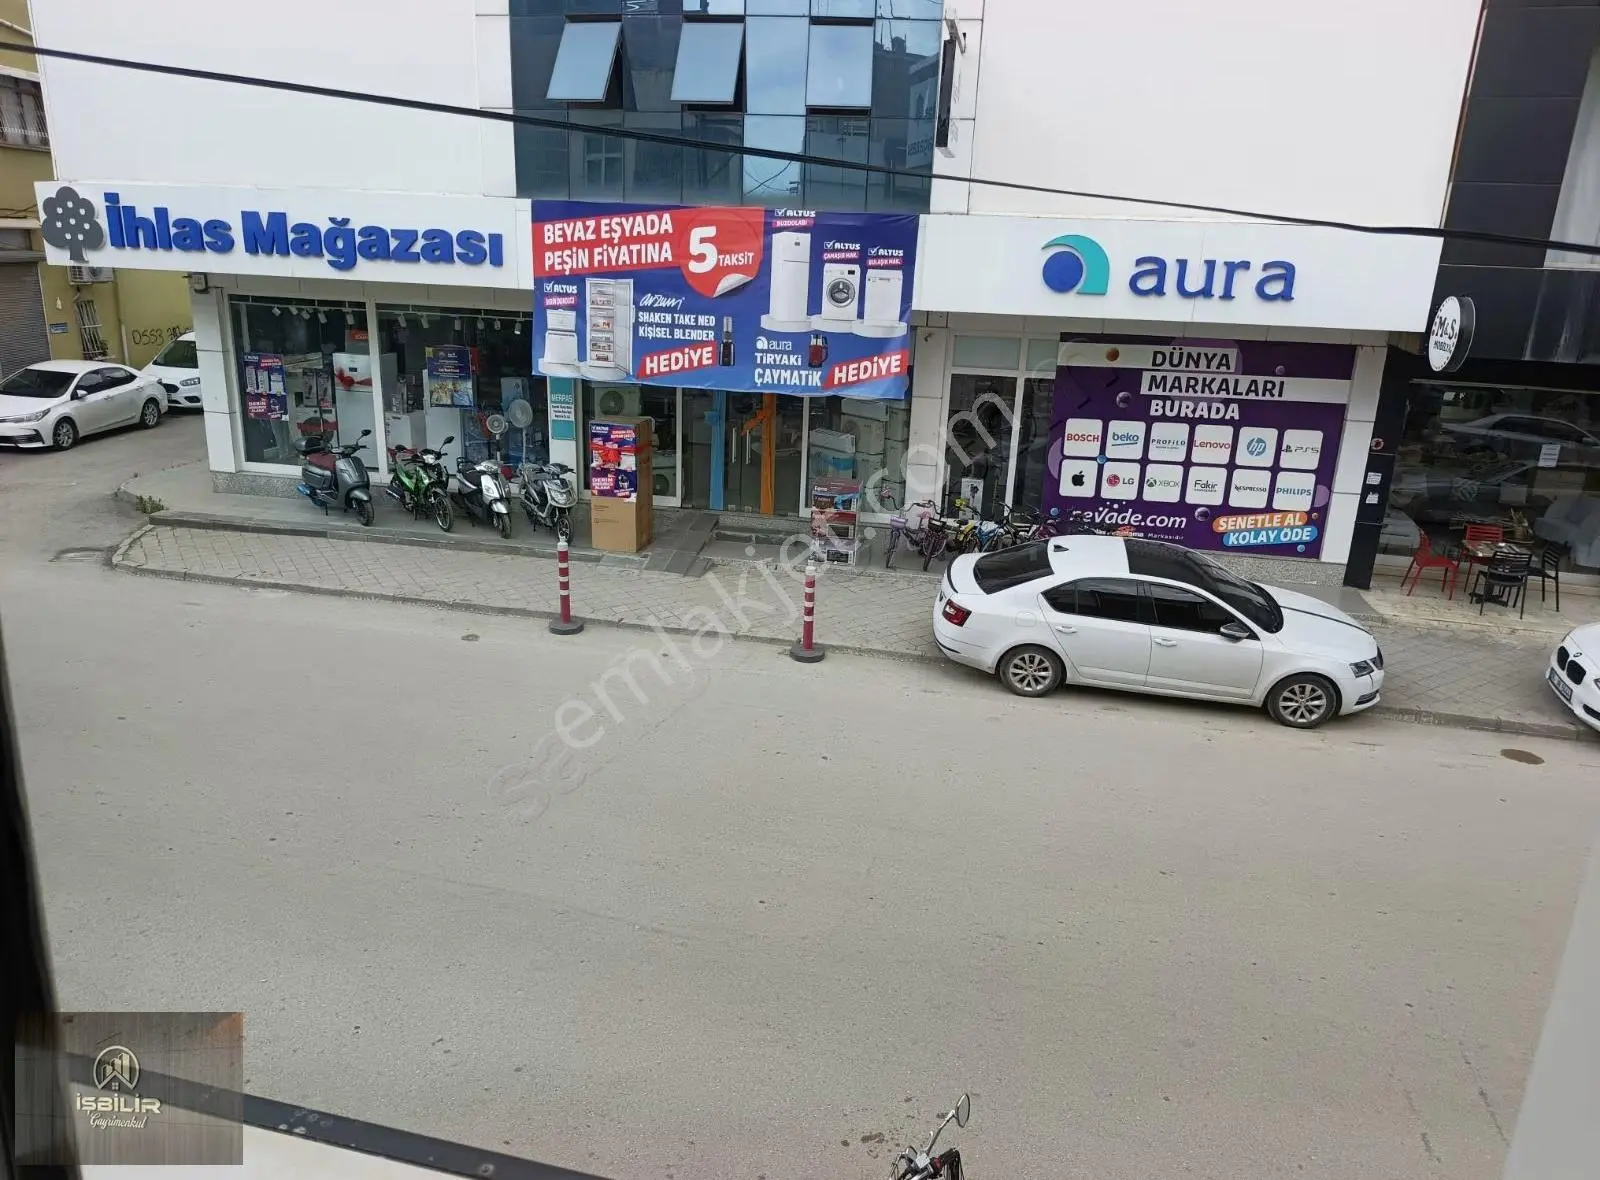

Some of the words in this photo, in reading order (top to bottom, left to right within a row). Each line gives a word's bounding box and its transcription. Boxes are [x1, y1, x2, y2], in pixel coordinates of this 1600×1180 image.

[786, 208, 817, 217] ALTUS
[104, 191, 236, 253] İhlas
[241, 210, 504, 272] Mağazası
[544, 219, 597, 245] BEYAZ
[601, 213, 673, 244] EŞYADA
[688, 226, 719, 273] 5
[834, 241, 861, 250] ALTUS
[878, 247, 904, 257] ALTUS
[1128, 255, 1296, 301] aura
[553, 283, 578, 294] ALTUS
[638, 311, 672, 324] SHAKEN
[673, 313, 697, 326] TAKE
[698, 315, 716, 327] NEO
[673, 327, 715, 341] BLENDER
[768, 339, 793, 351] aura
[645, 346, 713, 376] HEDİYE
[1151, 346, 1231, 371] DÜNYA
[754, 366, 823, 387] ÇAYMATİK
[833, 354, 902, 385] HEDİYE
[1147, 374, 1285, 398] MARKALARI
[1149, 399, 1241, 420] BURADA
[1066, 433, 1101, 443] BOSCH
[1111, 432, 1140, 443] beko
[1193, 439, 1231, 450] Lenovo
[1247, 437, 1266, 456] hp
[1294, 446, 1320, 454] PS5
[1122, 477, 1135, 486] LG
[1158, 480, 1181, 489] XBOX
[1194, 480, 1218, 490] Fakir
[1235, 483, 1268, 493] NESPRESSO
[1275, 487, 1312, 497] PHILIPS
[1218, 515, 1280, 531] SENETLE
[1283, 513, 1304, 526] AL
[1228, 529, 1279, 546] KOLAY
[1280, 526, 1312, 542] ÖDE
